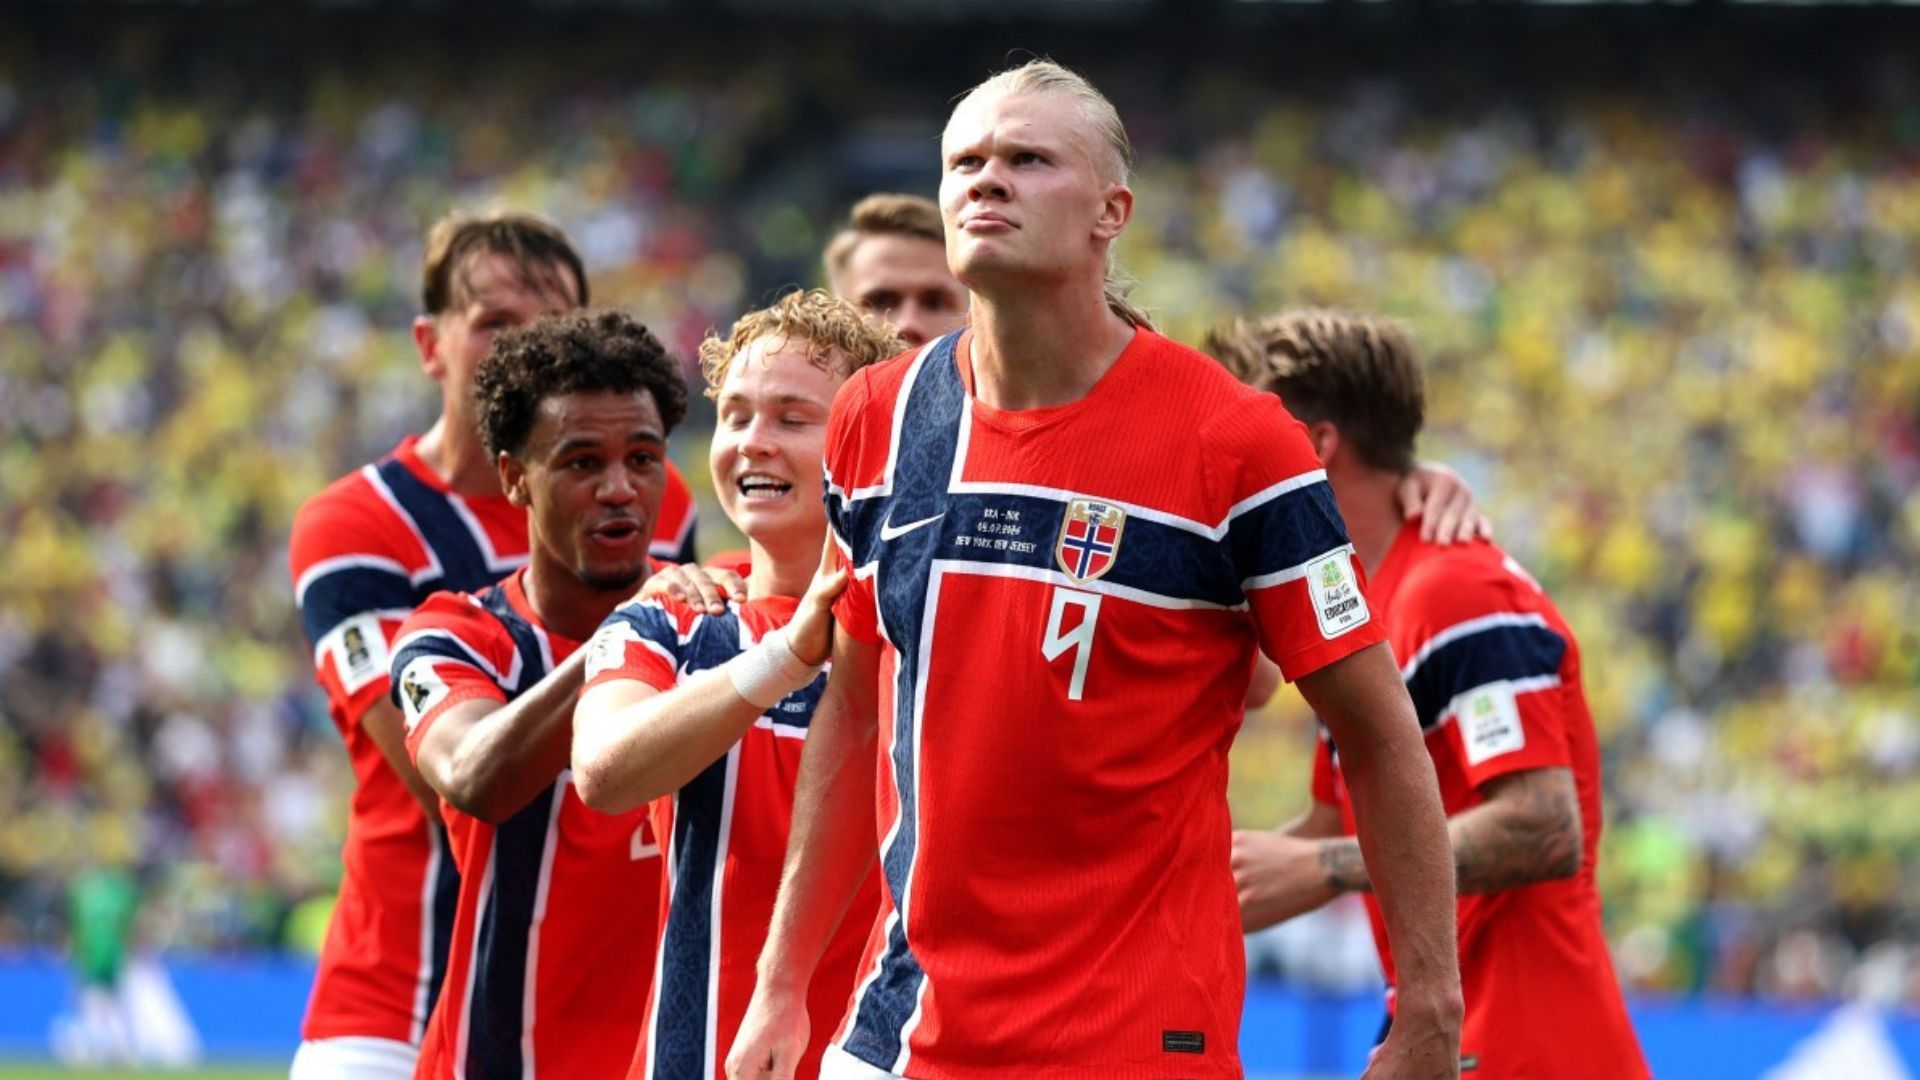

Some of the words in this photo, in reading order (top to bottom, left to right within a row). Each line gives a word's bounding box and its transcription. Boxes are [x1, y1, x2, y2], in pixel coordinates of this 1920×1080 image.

[984, 508, 999, 519] BRA
[1005, 510, 1020, 521] NOR
[955, 535, 972, 546] NEW
[973, 536, 993, 549] YORK
[993, 539, 1009, 551] NEW
[1009, 540, 1037, 553] JERSEY
[1324, 596, 1360, 621] EDUCATION
[1041, 586, 1102, 701] 9
